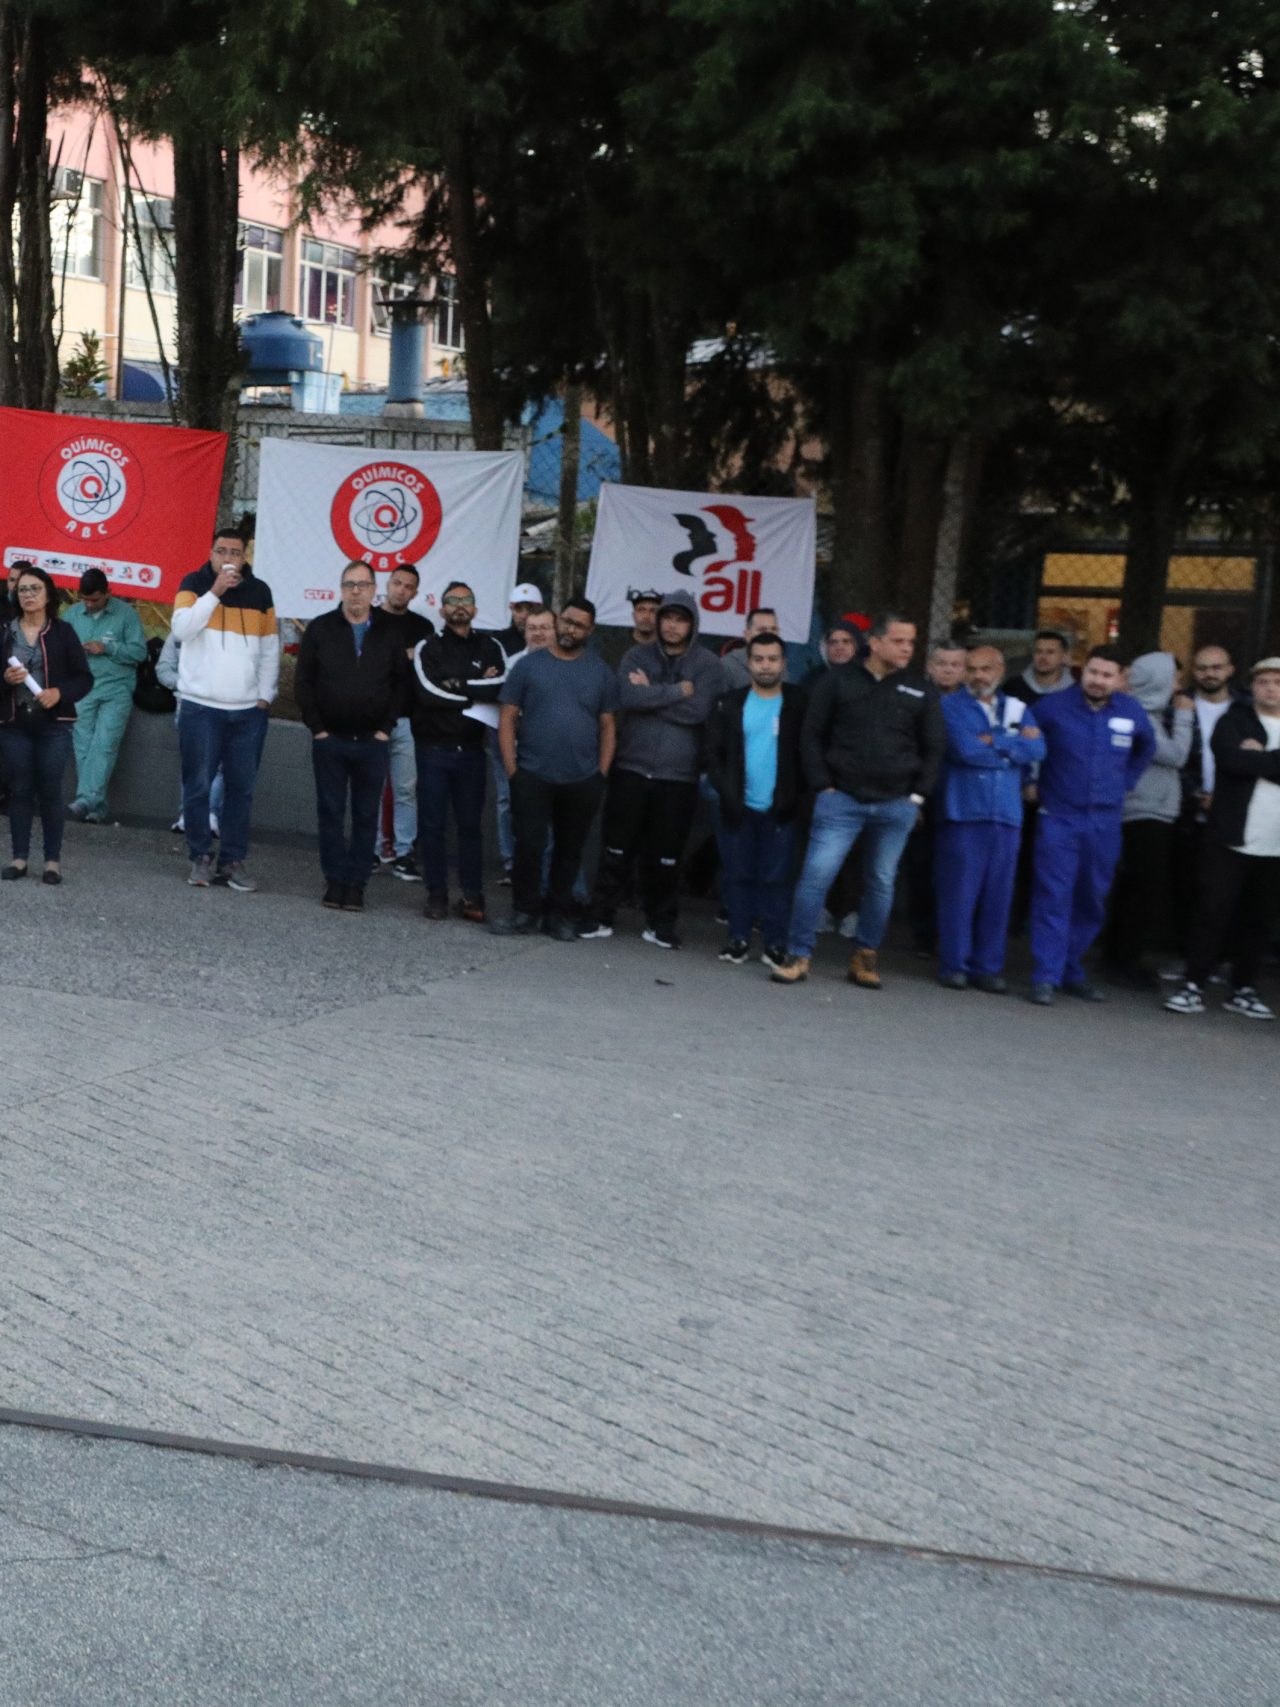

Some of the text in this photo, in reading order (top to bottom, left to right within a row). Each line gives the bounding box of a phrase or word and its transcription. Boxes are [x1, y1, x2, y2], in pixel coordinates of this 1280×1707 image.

[61, 436, 129, 467] QUÍMICOS
[351, 465, 425, 493] QUÍMICOS
[305, 590, 332, 600] CUT
